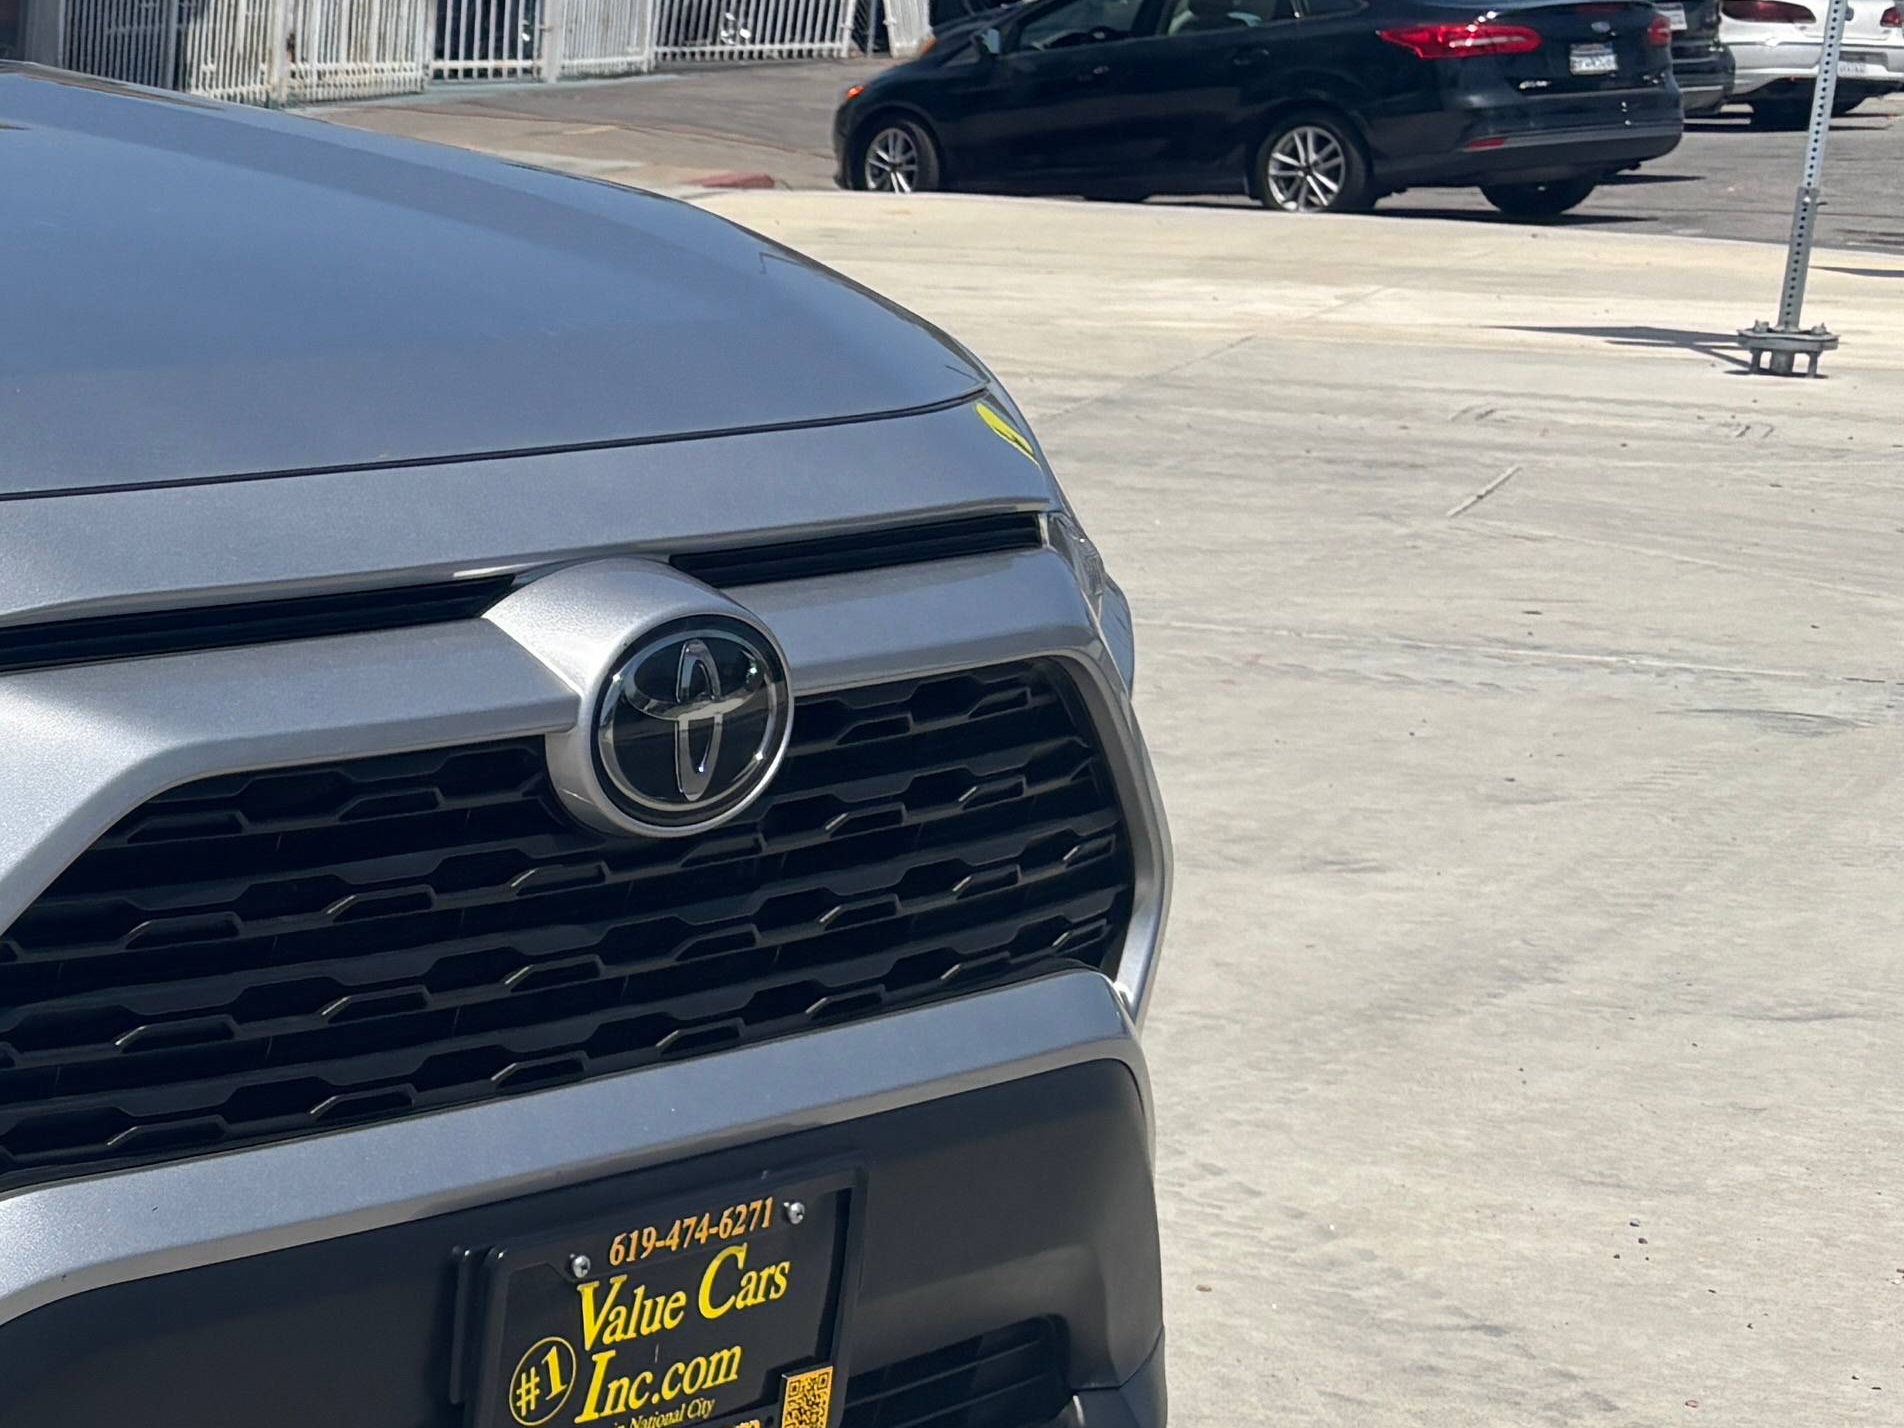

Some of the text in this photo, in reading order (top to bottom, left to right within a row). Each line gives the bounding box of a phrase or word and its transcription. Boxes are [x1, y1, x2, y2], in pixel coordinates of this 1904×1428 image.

[609, 1197, 773, 1266] 619-474-6271
[577, 1243, 790, 1351] Value Cars
[516, 1345, 741, 1424] #1 Inc.com
[687, 1397, 716, 1420] City
